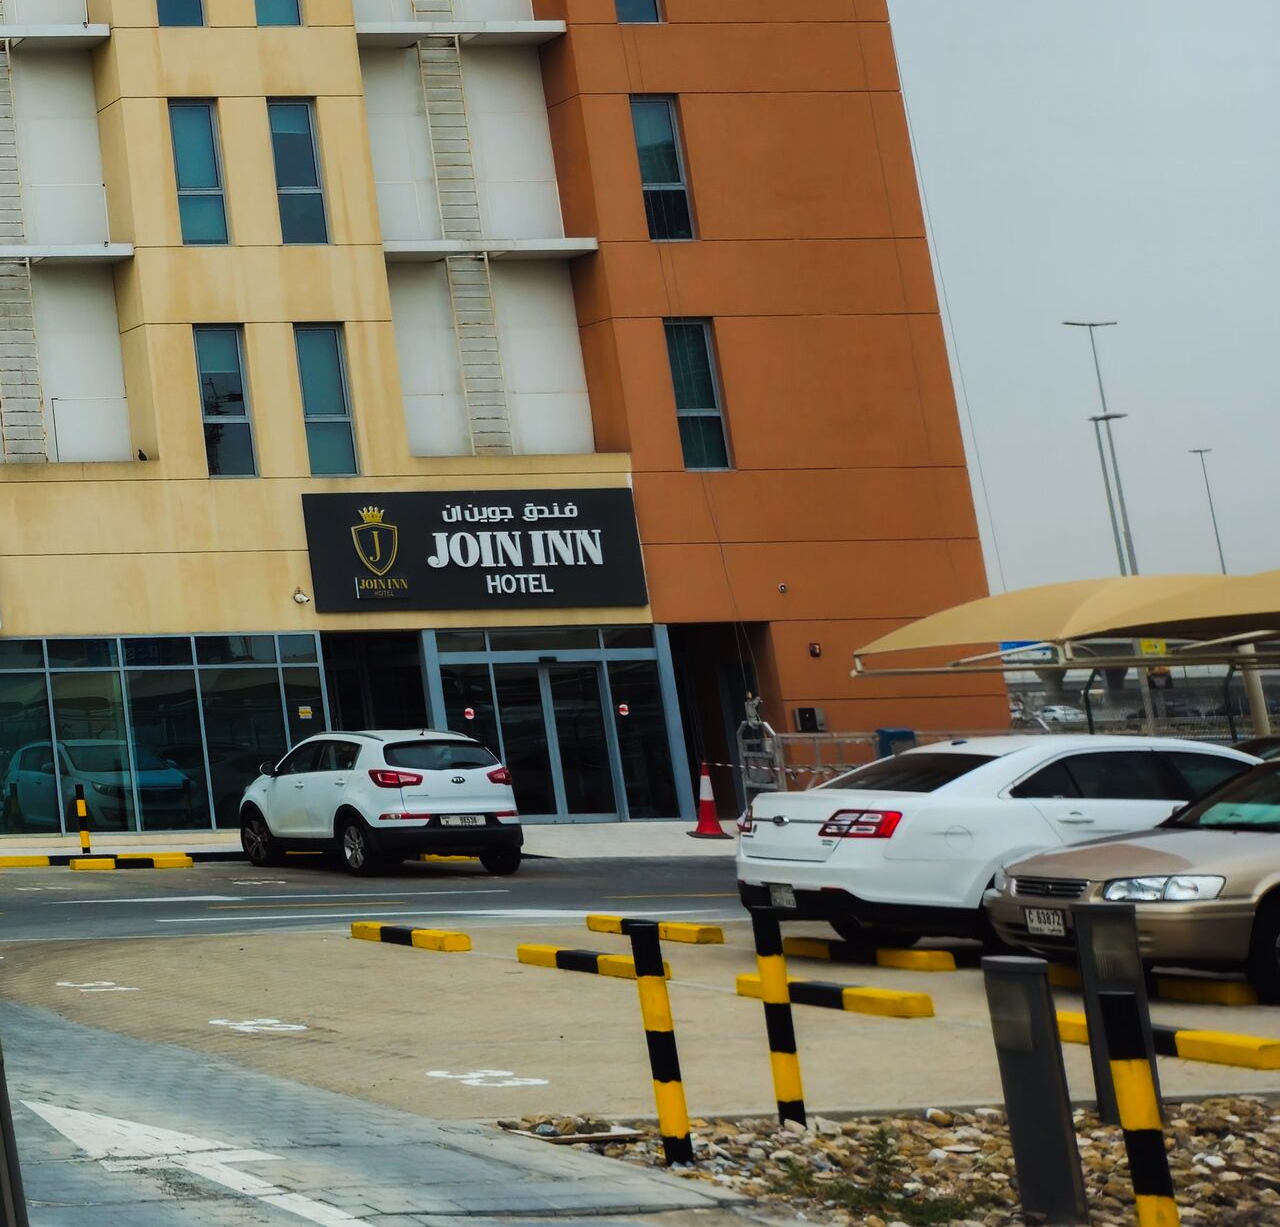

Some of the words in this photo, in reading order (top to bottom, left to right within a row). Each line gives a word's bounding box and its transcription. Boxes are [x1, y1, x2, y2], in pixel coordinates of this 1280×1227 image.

[442, 504, 462, 522] ان
[464, 504, 514, 522] جوين
[522, 502, 578, 522] فندق
[369, 530, 381, 562] J
[427, 531, 523, 568] JOIN
[528, 529, 603, 566] INN
[359, 578, 386, 589] JOIN
[387, 578, 408, 589] INN
[486, 574, 554, 594] HOTEL
